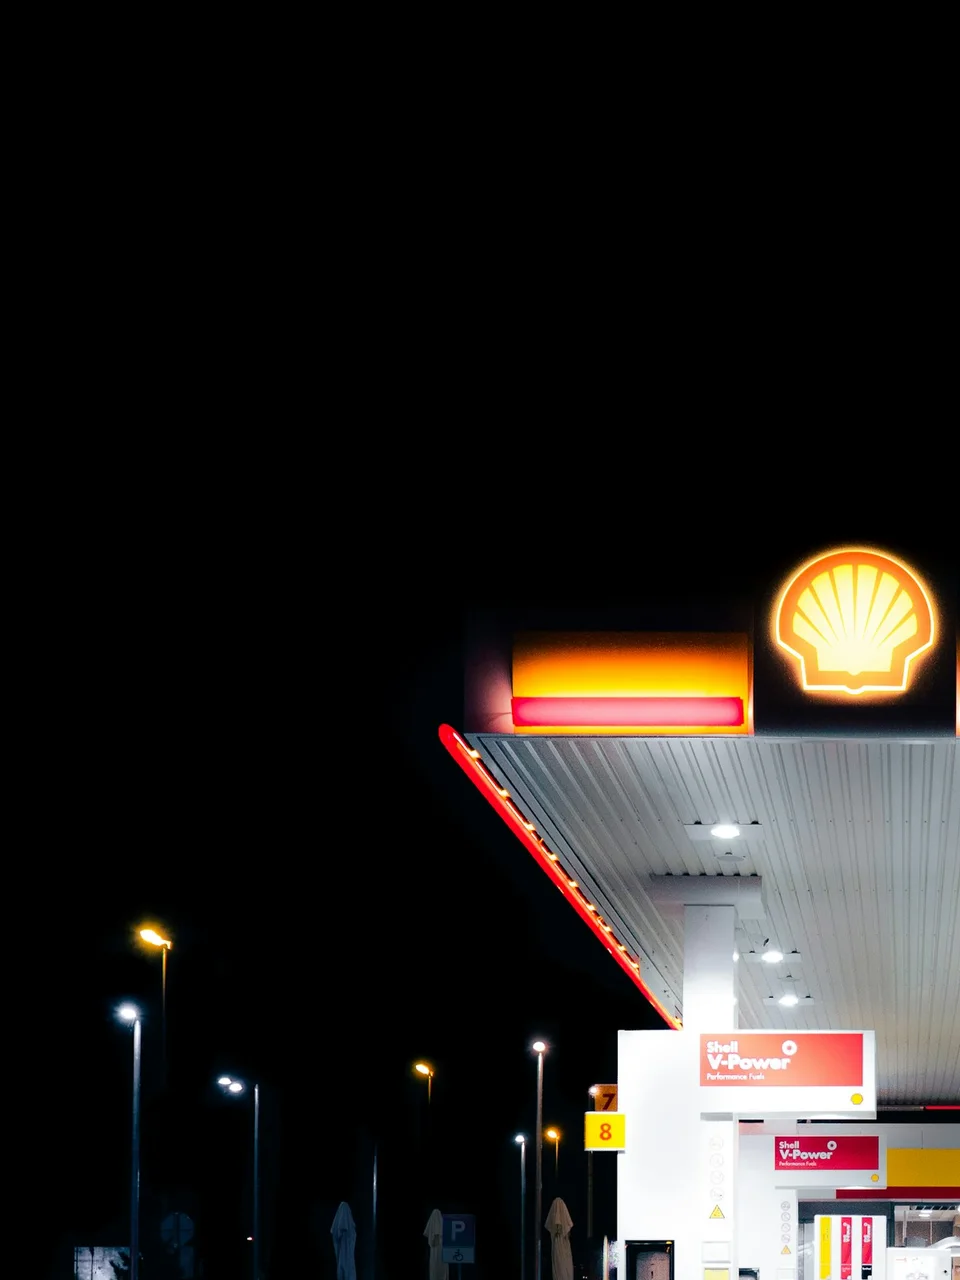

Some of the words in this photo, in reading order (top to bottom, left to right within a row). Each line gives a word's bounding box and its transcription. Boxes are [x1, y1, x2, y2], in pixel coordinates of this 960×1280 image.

[706, 1041, 738, 1053] Shell
[707, 1054, 791, 1070] V-Power
[706, 1072, 747, 1080] Performance
[749, 1072, 765, 1080] Fuels
[602, 1094, 616, 1111] 7
[599, 1123, 612, 1141] 8
[779, 1141, 799, 1149] Shell
[780, 1149, 833, 1160] V-Power
[451, 1220, 466, 1241] P
